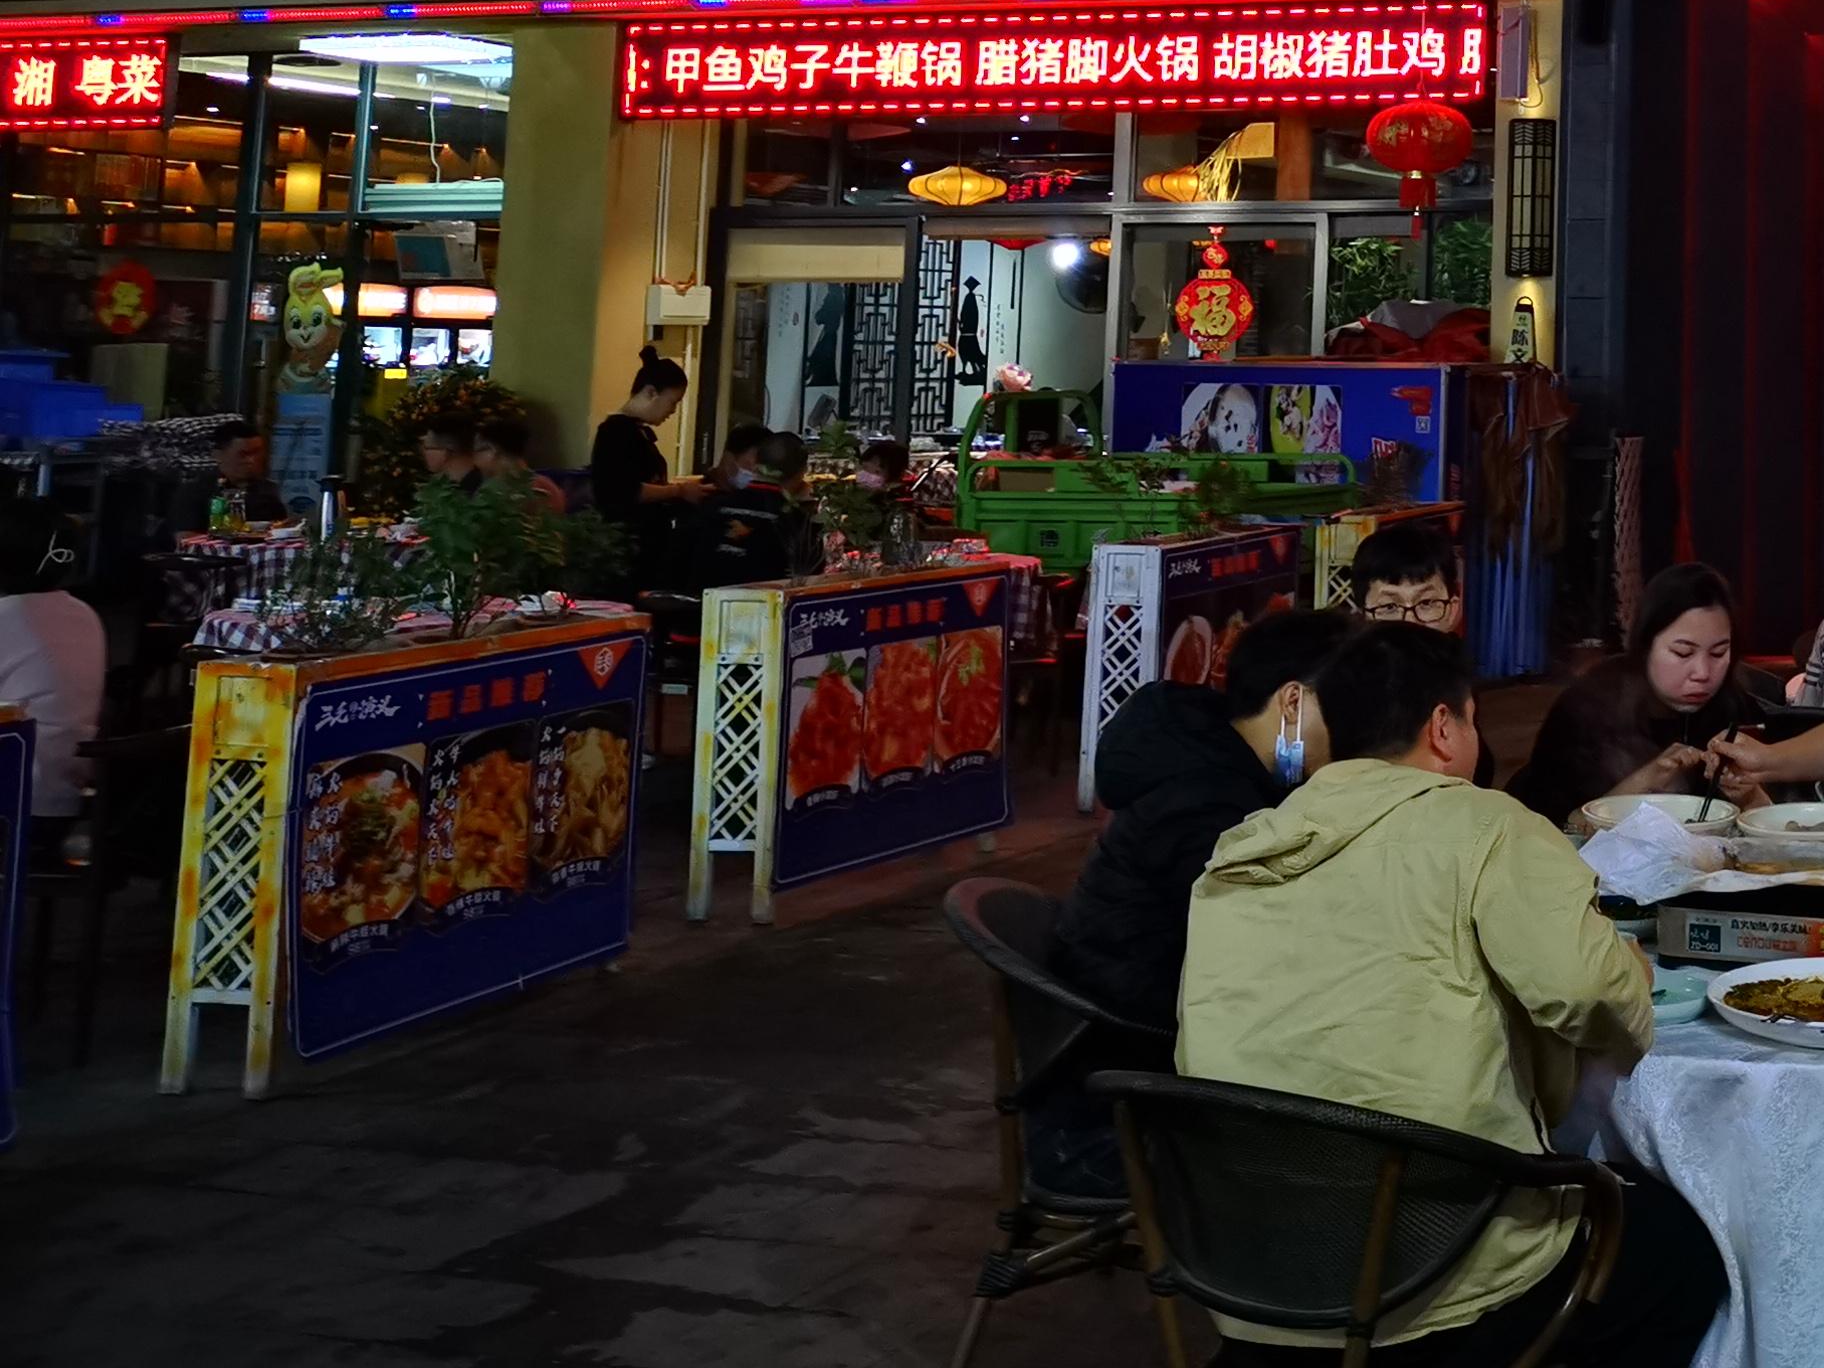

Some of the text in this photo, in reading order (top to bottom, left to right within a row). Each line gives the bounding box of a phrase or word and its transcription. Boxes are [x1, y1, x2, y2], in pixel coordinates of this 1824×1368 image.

[12, 53, 162, 108] 湘 粤菜
[664, 40, 962, 93] 甲鱼鸡子牛鞭锅
[975, 35, 1198, 87] 腊猪脚火锅
[1213, 28, 1445, 81] 胡椒猪肚鸡
[1190, 284, 1236, 336] 福
